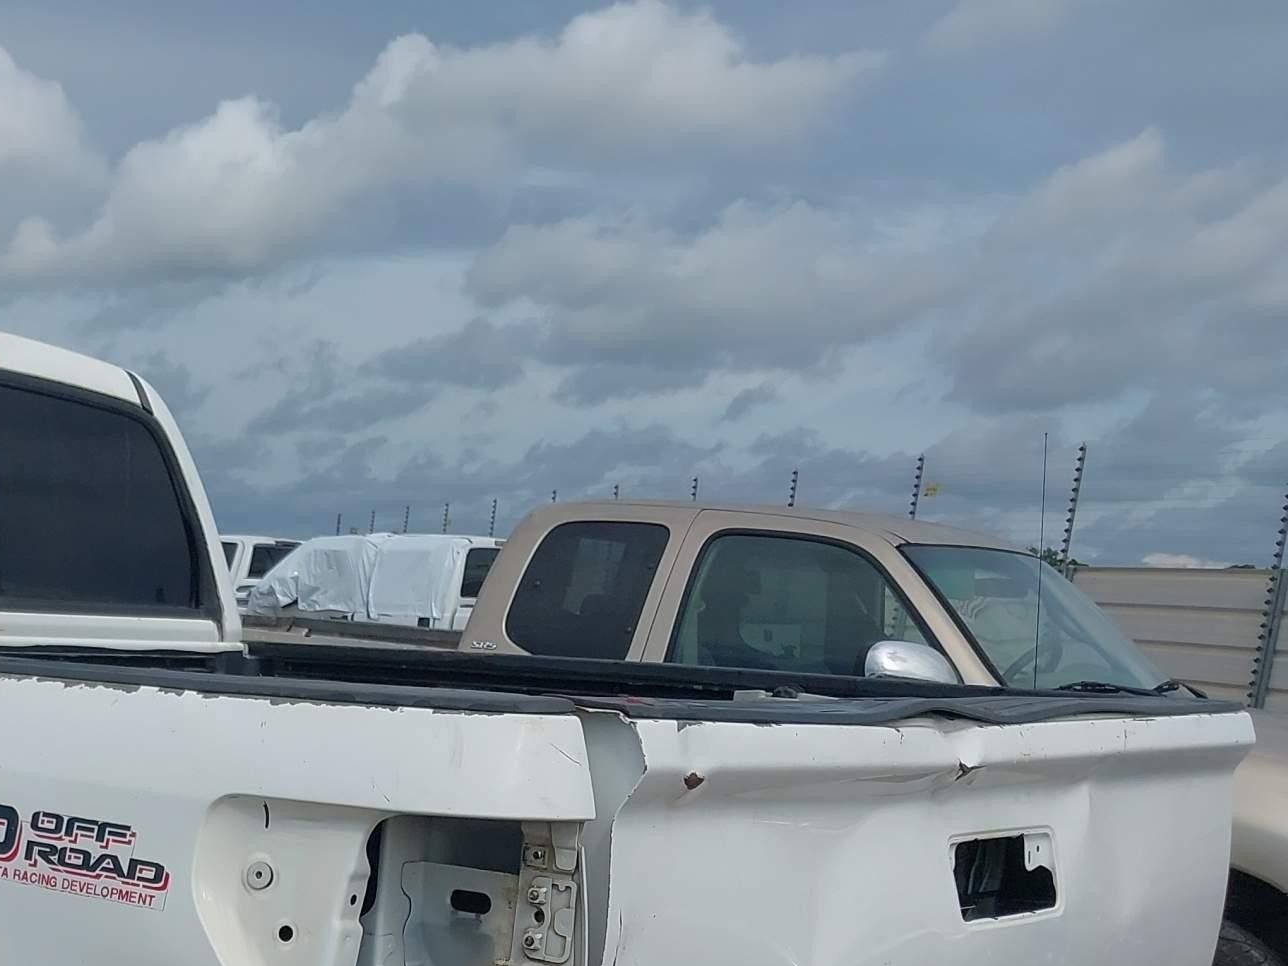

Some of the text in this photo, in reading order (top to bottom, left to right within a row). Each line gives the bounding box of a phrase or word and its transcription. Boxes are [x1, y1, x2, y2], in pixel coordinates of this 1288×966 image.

[30, 810, 136, 848] OFF
[23, 840, 170, 892] ROAD
[12, 869, 58, 889] RACING
[60, 879, 156, 907] DEVELOPMENT
